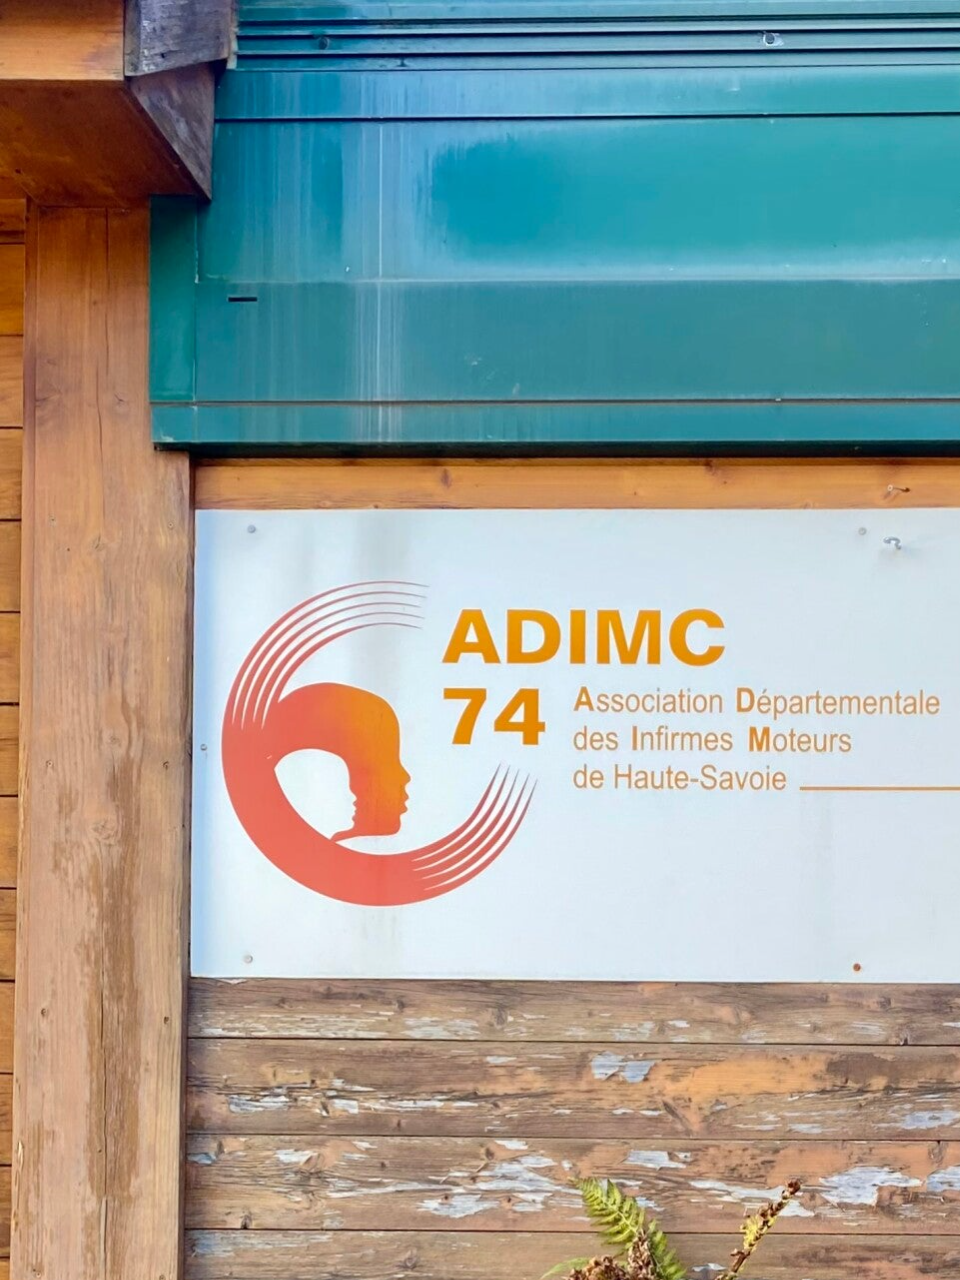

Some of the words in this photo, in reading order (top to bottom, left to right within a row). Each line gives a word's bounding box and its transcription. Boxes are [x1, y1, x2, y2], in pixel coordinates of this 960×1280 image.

[441, 608, 725, 666] ADIMC
[442, 688, 546, 746] 74
[573, 686, 724, 715] Association
[735, 686, 941, 720] Départementale
[572, 727, 619, 752] des
[631, 725, 733, 752] Infirmes
[748, 725, 852, 754] Moteurs
[572, 764, 606, 791] de
[613, 763, 787, 792] Haute-Savoie
